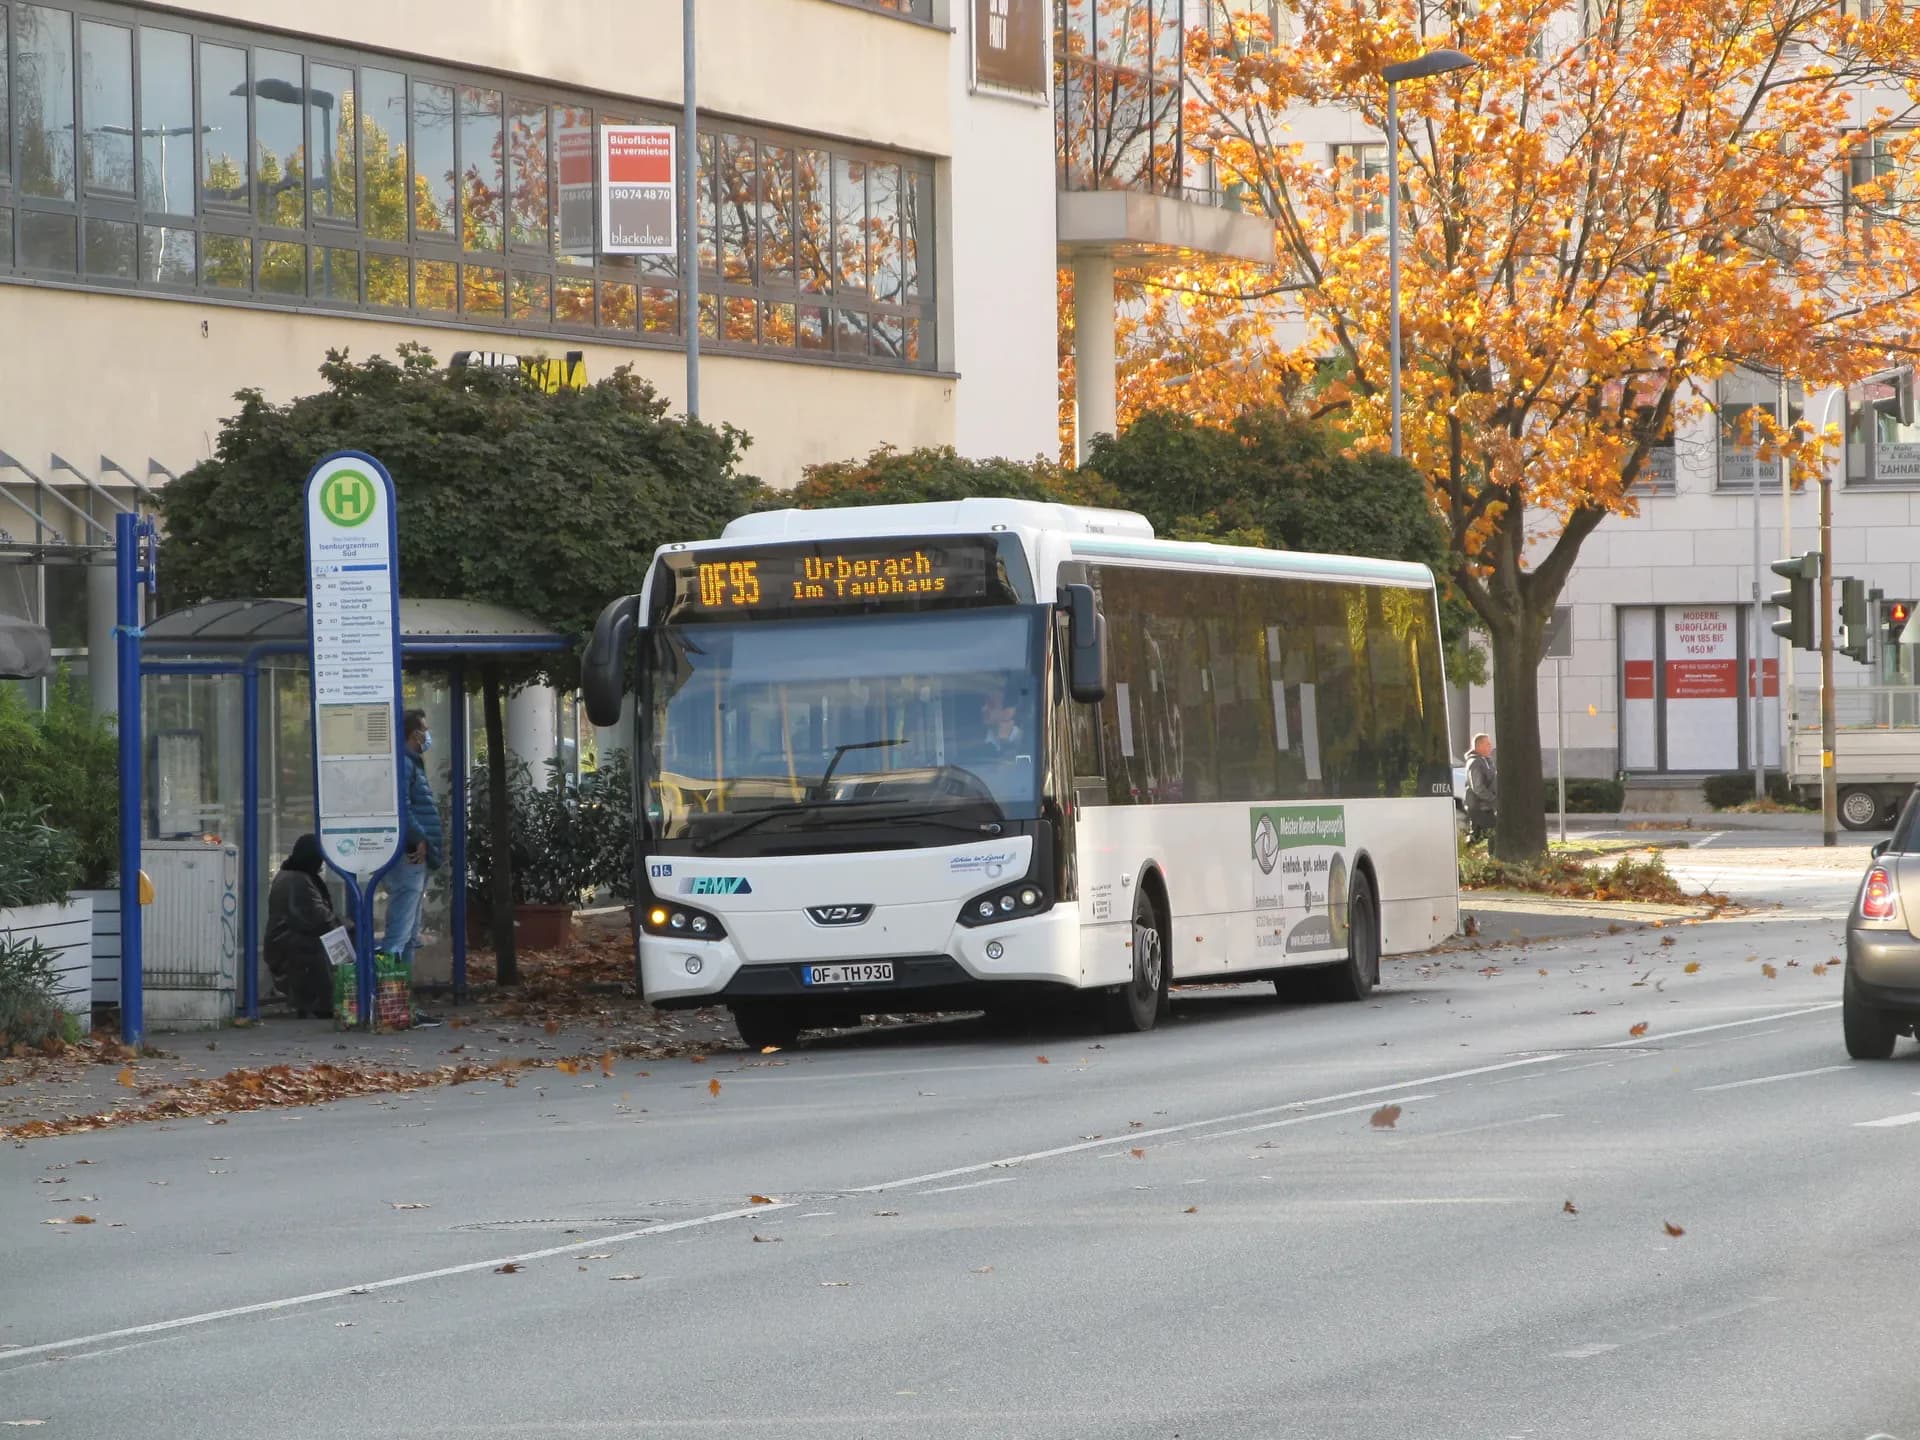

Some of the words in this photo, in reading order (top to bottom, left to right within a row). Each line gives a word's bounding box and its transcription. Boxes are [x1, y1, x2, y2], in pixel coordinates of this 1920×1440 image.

[610, 135, 669, 145] Büroflächen
[623, 146, 669, 156] vermieten
[334, 482, 361, 514] H
[699, 560, 760, 605] OF95
[804, 551, 932, 580] Urberach
[793, 582, 824, 599] Im
[833, 577, 945, 597] Taubhaus
[1683, 611, 1720, 620] MODERNE
[1680, 634, 1695, 642] VON
[1697, 634, 1710, 642] 185
[1712, 634, 1724, 642] BIS
[1687, 645, 1704, 654] 1450
[1432, 783, 1451, 793] CITEA
[816, 907, 862, 919] VDL
[812, 967, 831, 982] OF
